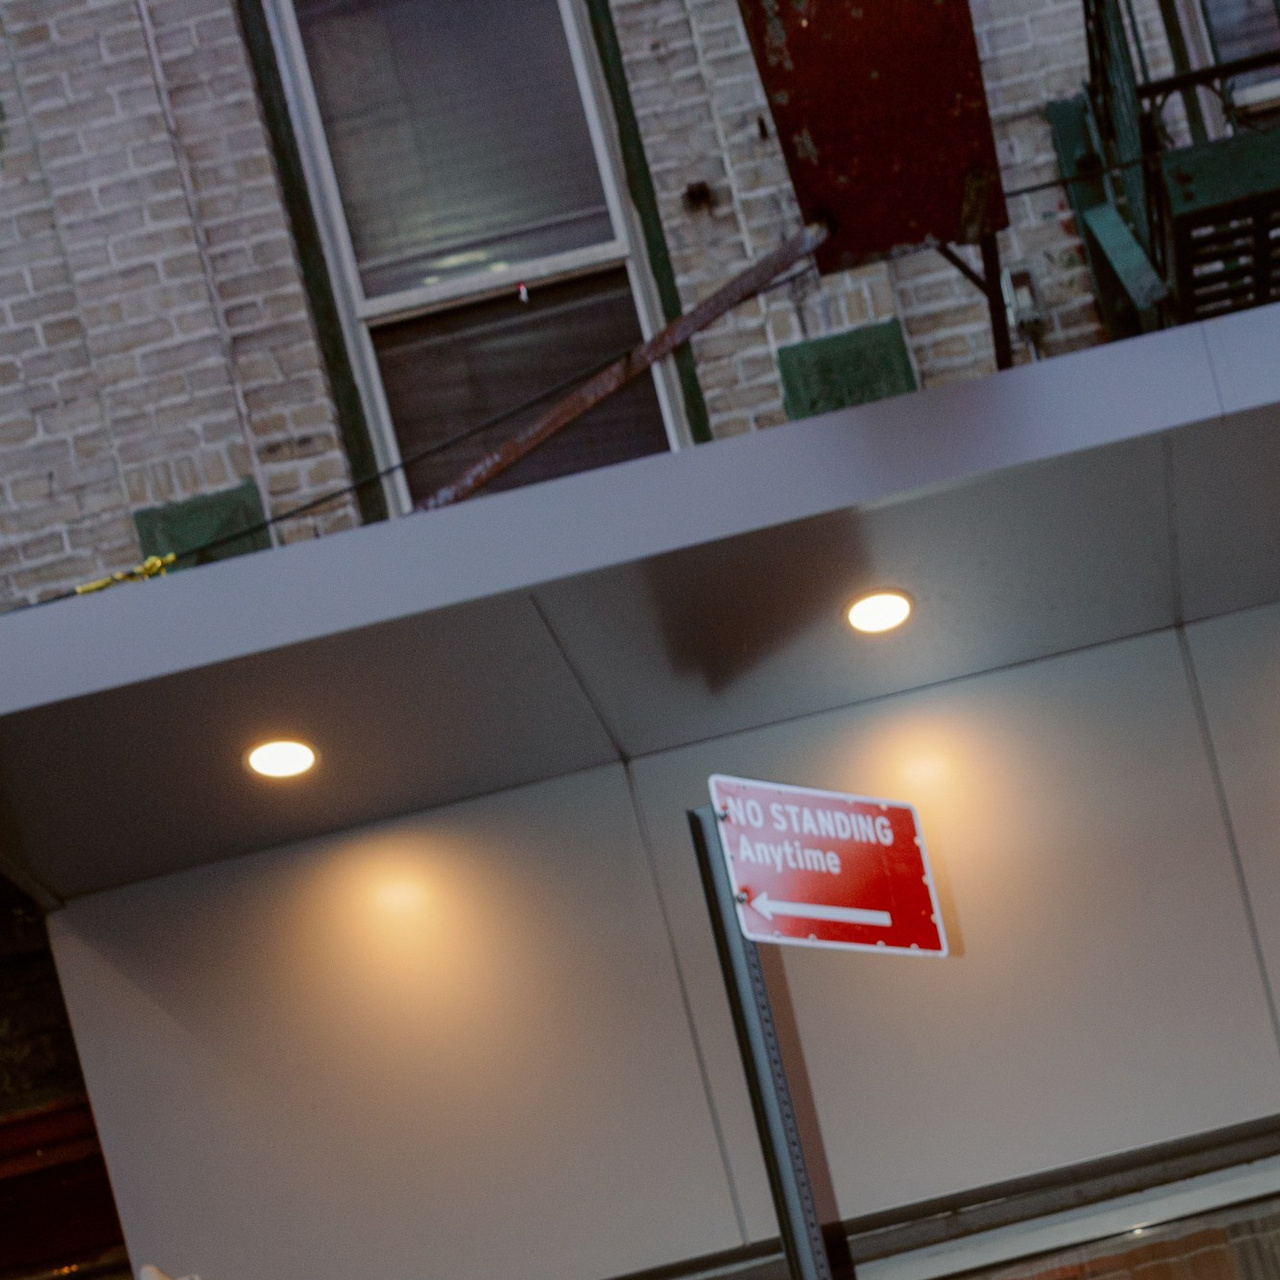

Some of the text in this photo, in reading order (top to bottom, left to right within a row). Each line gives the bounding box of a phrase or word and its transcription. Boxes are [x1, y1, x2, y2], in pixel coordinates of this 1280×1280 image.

[725, 796, 895, 846] NO STANDING
[738, 836, 842, 875] Anytime
